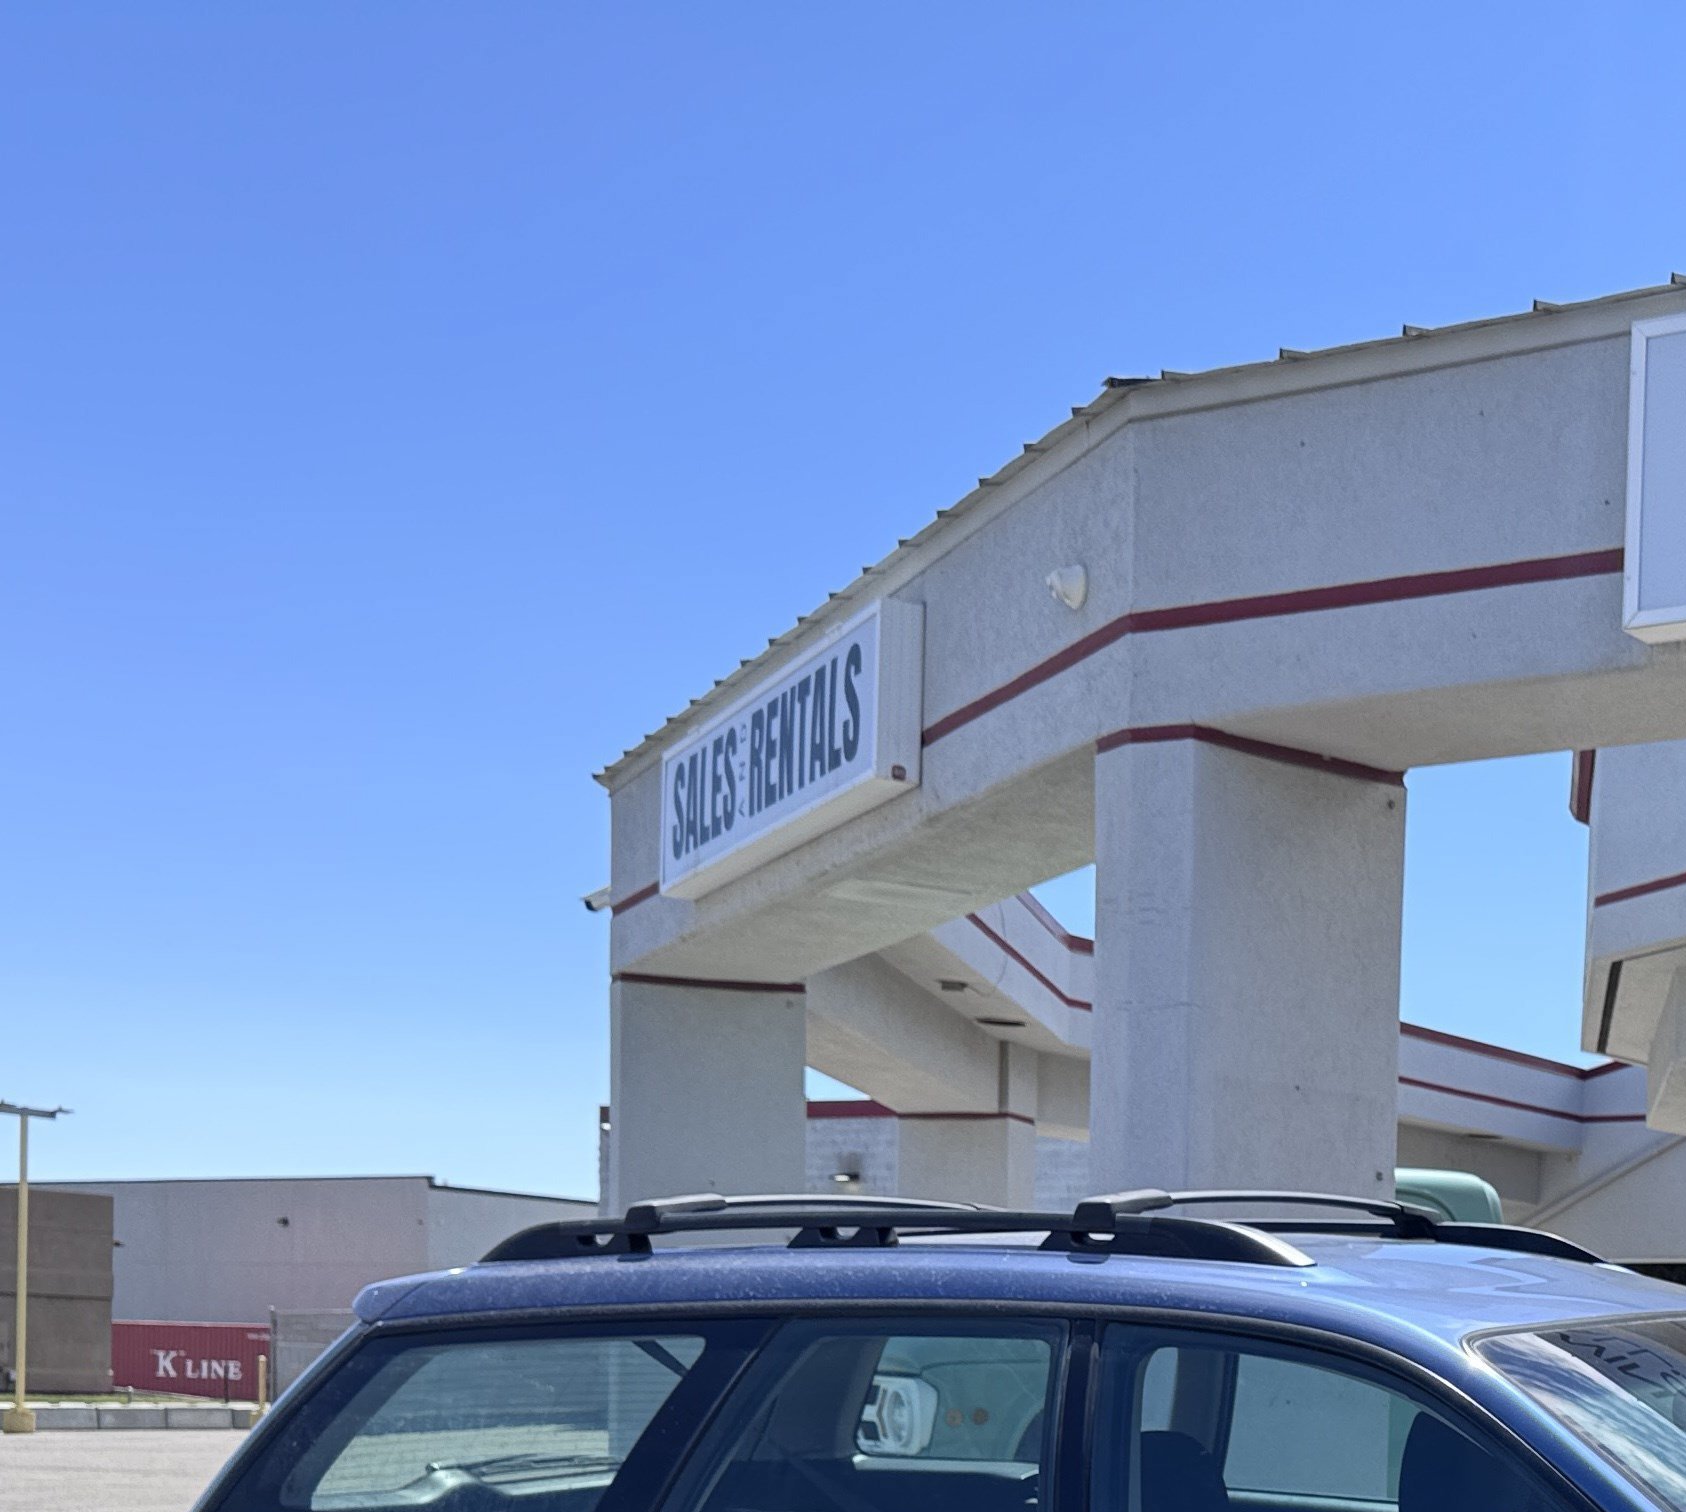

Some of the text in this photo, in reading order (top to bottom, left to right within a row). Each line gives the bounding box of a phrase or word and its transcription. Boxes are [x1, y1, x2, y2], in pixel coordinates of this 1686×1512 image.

[672, 727, 737, 860] SALES
[749, 643, 862, 818] RENTALS
[184, 1358, 242, 1381] LINE
